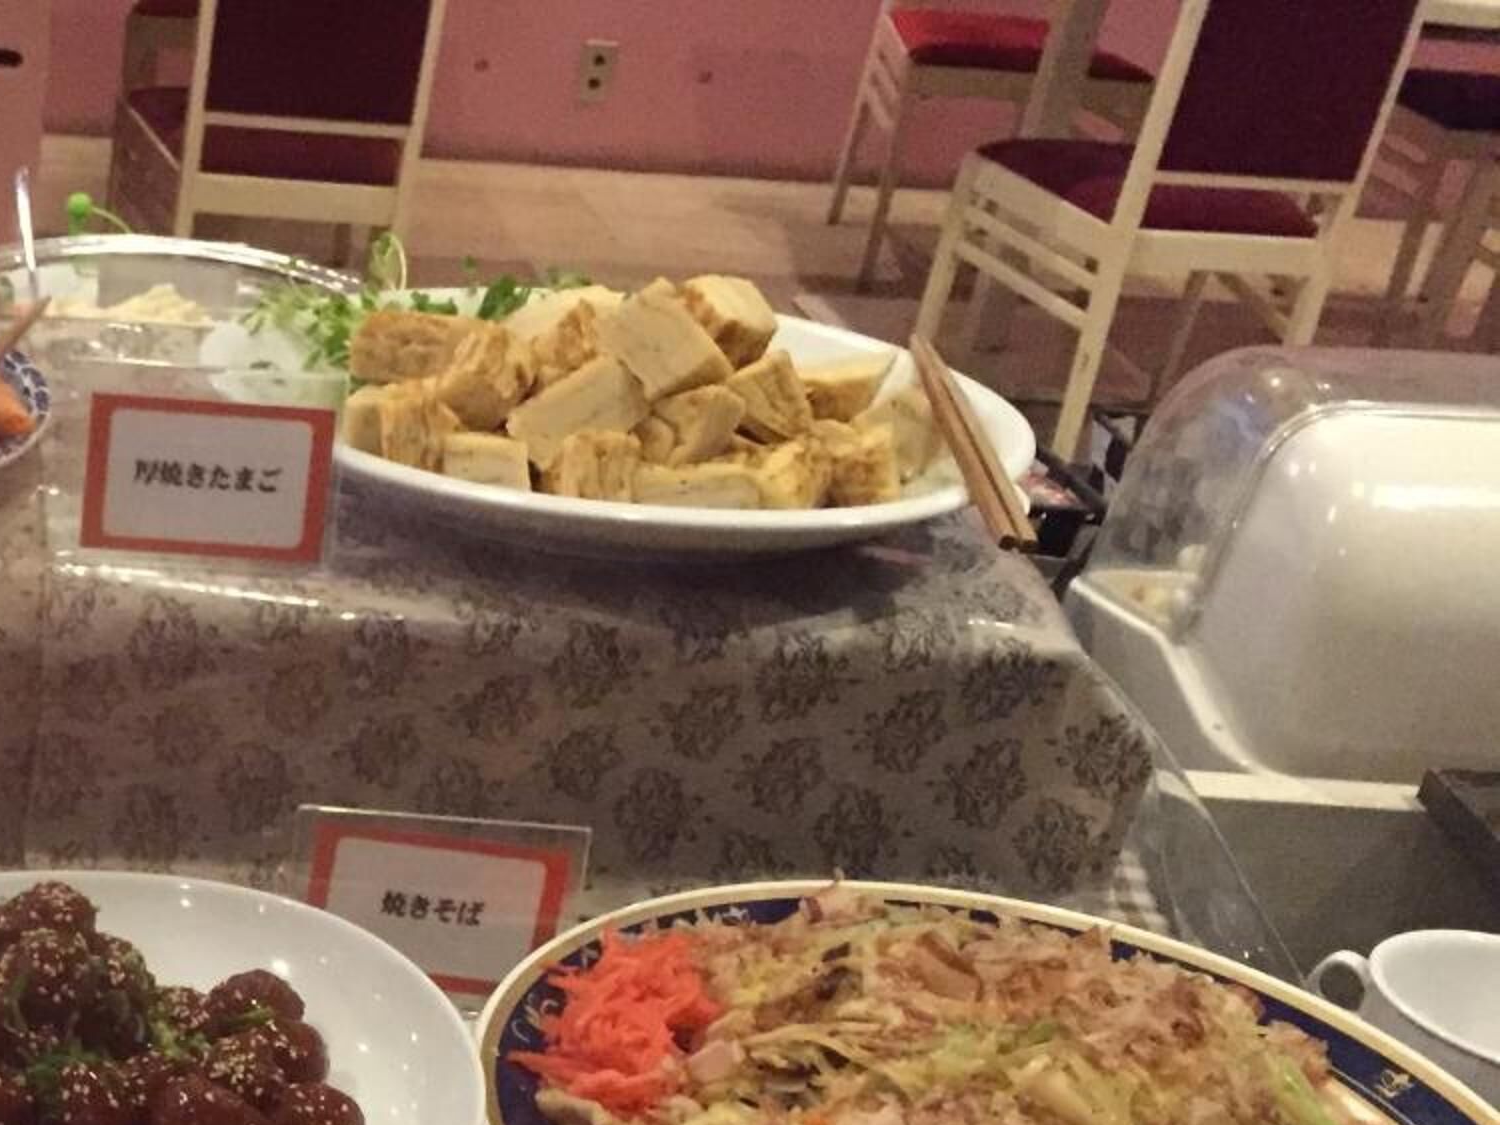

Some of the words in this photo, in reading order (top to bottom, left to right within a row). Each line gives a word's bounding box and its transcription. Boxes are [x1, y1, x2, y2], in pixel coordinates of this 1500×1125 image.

[132, 457, 282, 495] 厚焼きたまご
[380, 889, 486, 927] 焼きそば
